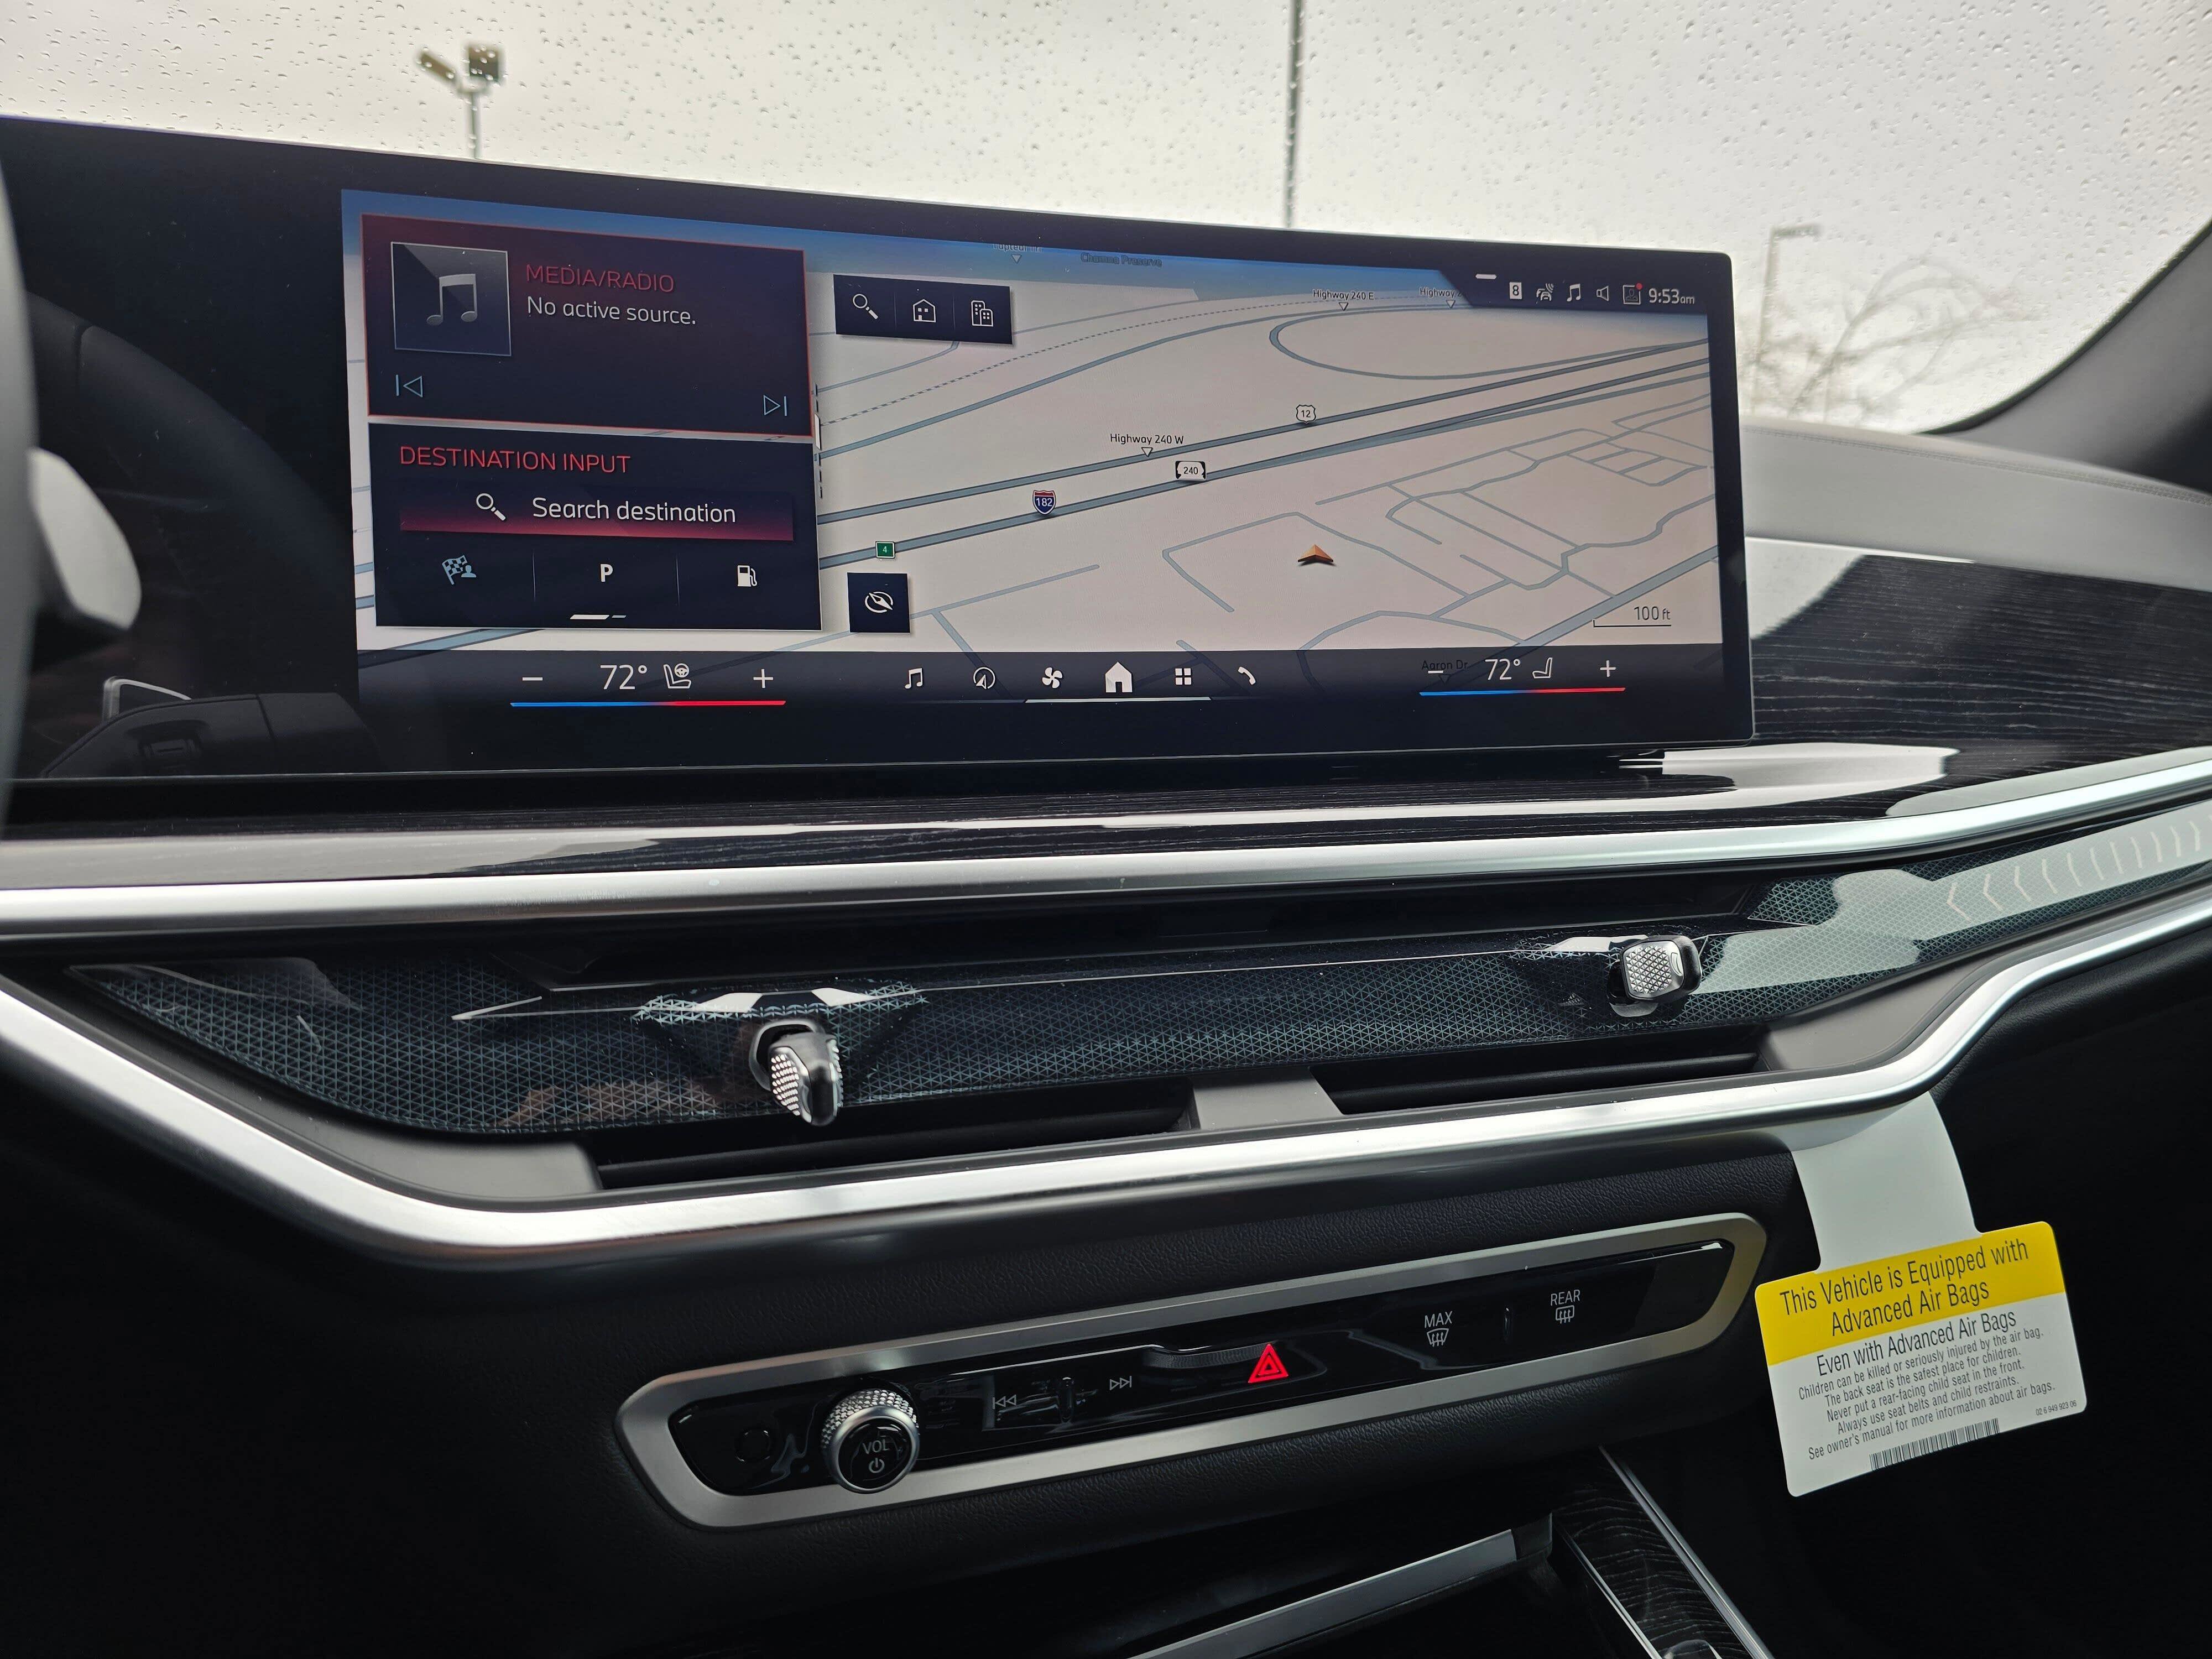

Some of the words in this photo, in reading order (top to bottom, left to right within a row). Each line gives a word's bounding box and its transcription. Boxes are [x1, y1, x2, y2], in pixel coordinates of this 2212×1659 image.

[1121, 255, 1162, 267] Preserve
[526, 264, 674, 293] MEDIA/RADIO
[1313, 289, 1349, 300] Highway
[1351, 291, 1366, 300] 240
[1420, 288, 1455, 299] Highway
[528, 296, 556, 316] No
[563, 299, 620, 321] active
[627, 306, 696, 325] source.
[1301, 410, 1311, 418] 12
[1110, 433, 1152, 445] Highway
[1155, 435, 1172, 444] 240
[1174, 435, 1184, 444] W
[400, 446, 556, 471] DESTINATION
[563, 453, 632, 473] INPUT
[1183, 466, 1199, 475] 240
[533, 497, 609, 520] Search
[617, 500, 736, 523] destination
[1036, 498, 1052, 507] 182
[600, 564, 613, 582] P
[1634, 606, 1660, 620] 100
[1662, 608, 1671, 620] ft
[1421, 660, 1453, 670] Aaron
[1456, 660, 1468, 670] Dr
[1780, 1286, 1817, 1315] This
[1820, 1271, 1883, 1305] Vehicle
[1887, 1266, 1903, 1289] is
[1907, 1245, 1986, 1286] Equipped
[1991, 1239, 2028, 1265] with
[1550, 1289, 1580, 1306] REAR
[1832, 1293, 1913, 1337] Advanced
[1920, 1288, 1942, 1314] Air
[1947, 1281, 1989, 1307] Bags
[1424, 1311, 1453, 1328] MAX
[1817, 1352, 1850, 1376] Even
[1853, 1340, 1884, 1365] with
[1888, 1321, 1954, 1357] Advanced
[1959, 1317, 1977, 1339] Air
[1981, 1312, 2016, 1333] Bags
[1799, 1381, 1834, 1400] Children
[1837, 1376, 1852, 1388] can
[1854, 1371, 1865, 1383] be
[1867, 1363, 1890, 1379] killed
[1893, 1361, 1902, 1372] or
[1905, 1349, 1944, 1369] seriously
[1947, 1341, 1977, 1359] injured
[1980, 1339, 1990, 1350] by
[1993, 1334, 2007, 1347] the
[2010, 1331, 2021, 1343] air
[2023, 1328, 2044, 1339] bag.
[1825, 1394, 1841, 1407] The
[1843, 1385, 1864, 1402] back
[1866, 1380, 1885, 1395] seat
[1886, 1378, 1895, 1390] is
[1897, 1373, 1910, 1386] the
[1913, 1365, 1940, 1382] safest
[1942, 1360, 1964, 1377] place
[1967, 1356, 1979, 1366] for
[1983, 1347, 2021, 1364] children.
[1827, 1407, 1851, 1422] Never
[1854, 1399, 1869, 1417] put
[1871, 1399, 1876, 1408] a
[1879, 1384, 1926, 1406] rear-facing
[1928, 1376, 1949, 1392] child
[1952, 1371, 1970, 1386] seat
[1973, 1369, 1981, 1381] in
[1983, 1365, 1997, 1378] the
[2000, 1359, 2025, 1374] front.
[1838, 1417, 1867, 1434] Always
[1870, 1412, 1885, 1424] use
[1887, 1404, 1906, 1418] seat
[1908, 1397, 1929, 1413] belts
[1932, 1393, 1948, 1406] and
[1950, 1385, 1971, 1401] child
[1974, 1375, 2019, 1395] restraints.
[1808, 1446, 1824, 1460] See
[1827, 1433, 1860, 1454] owner's
[1862, 1422, 1893, 1443] manual
[1896, 1420, 1908, 1432] for
[1911, 1412, 1933, 1427] more
[1936, 1398, 1986, 1421] information
[1989, 1390, 2014, 1406] about
[2017, 1386, 2027, 1399] air
[2031, 1382, 2056, 1395] bags.
[863, 1439, 890, 1454] VOL
